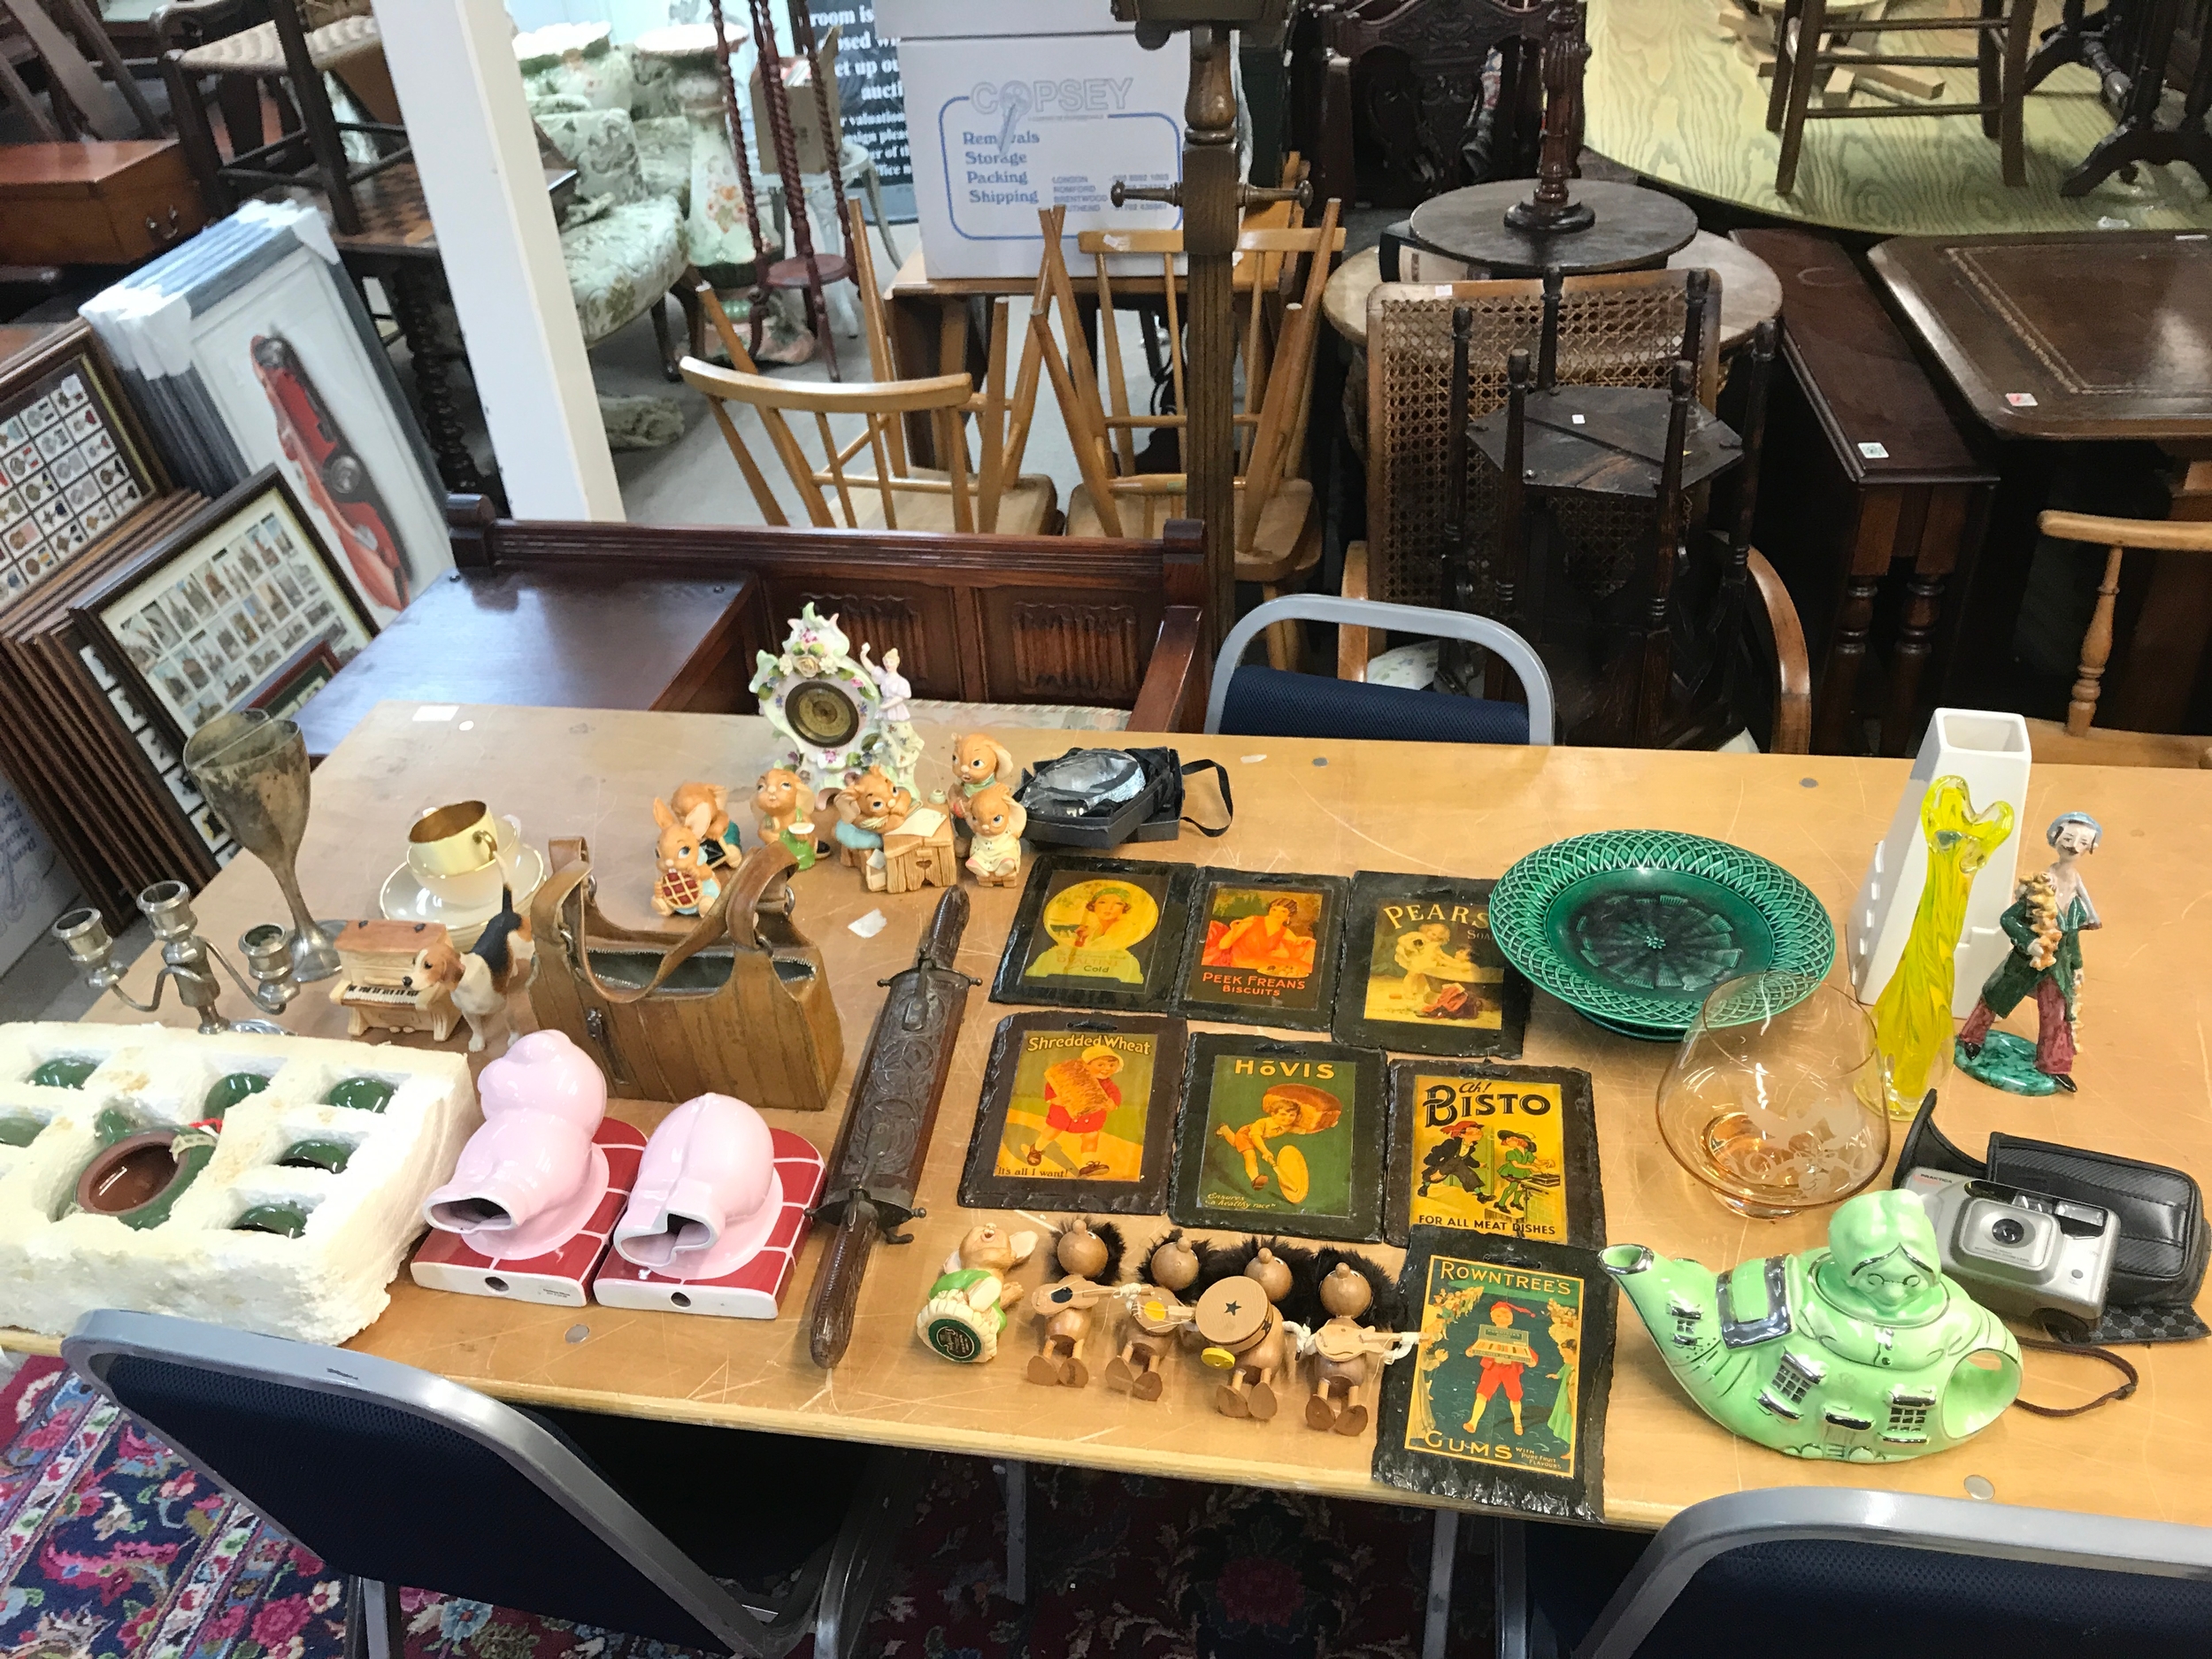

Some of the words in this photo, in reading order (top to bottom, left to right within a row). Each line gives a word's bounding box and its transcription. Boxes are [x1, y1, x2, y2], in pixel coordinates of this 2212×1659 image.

[810, 10, 856, 27] room
[858, 4, 875, 24] is
[855, 59, 878, 80] up
[972, 77, 1133, 115] COPSEY
[965, 150, 1027, 166] Storage
[966, 171, 1028, 186] Packing
[969, 189, 1040, 205] Shipping
[1383, 903, 1490, 929] PEARS
[1467, 929, 1494, 941] SOA
[1083, 964, 1110, 973] Cold
[1202, 972, 1242, 985] PEEK
[1248, 976, 1306, 990] FREAN'S
[1222, 984, 1281, 996] BISCUITS
[1027, 1034, 1102, 1051] Shredded
[1103, 1035, 1151, 1055] Wheat
[1458, 1081, 1492, 1094] Ah!
[1423, 1085, 1551, 1127] BISTO
[1217, 1199, 1251, 1210] healthy
[1418, 1215, 1443, 1225] FOR
[1447, 1218, 1470, 1228] ALL
[1473, 1219, 1508, 1231] MEAT
[1512, 1223, 1556, 1235] DISHES
[1440, 1260, 1571, 1295] ROWNTREE'S
[1424, 1430, 1513, 1460] GUMS
[1529, 1459, 1562, 1470] FLAVOURS
